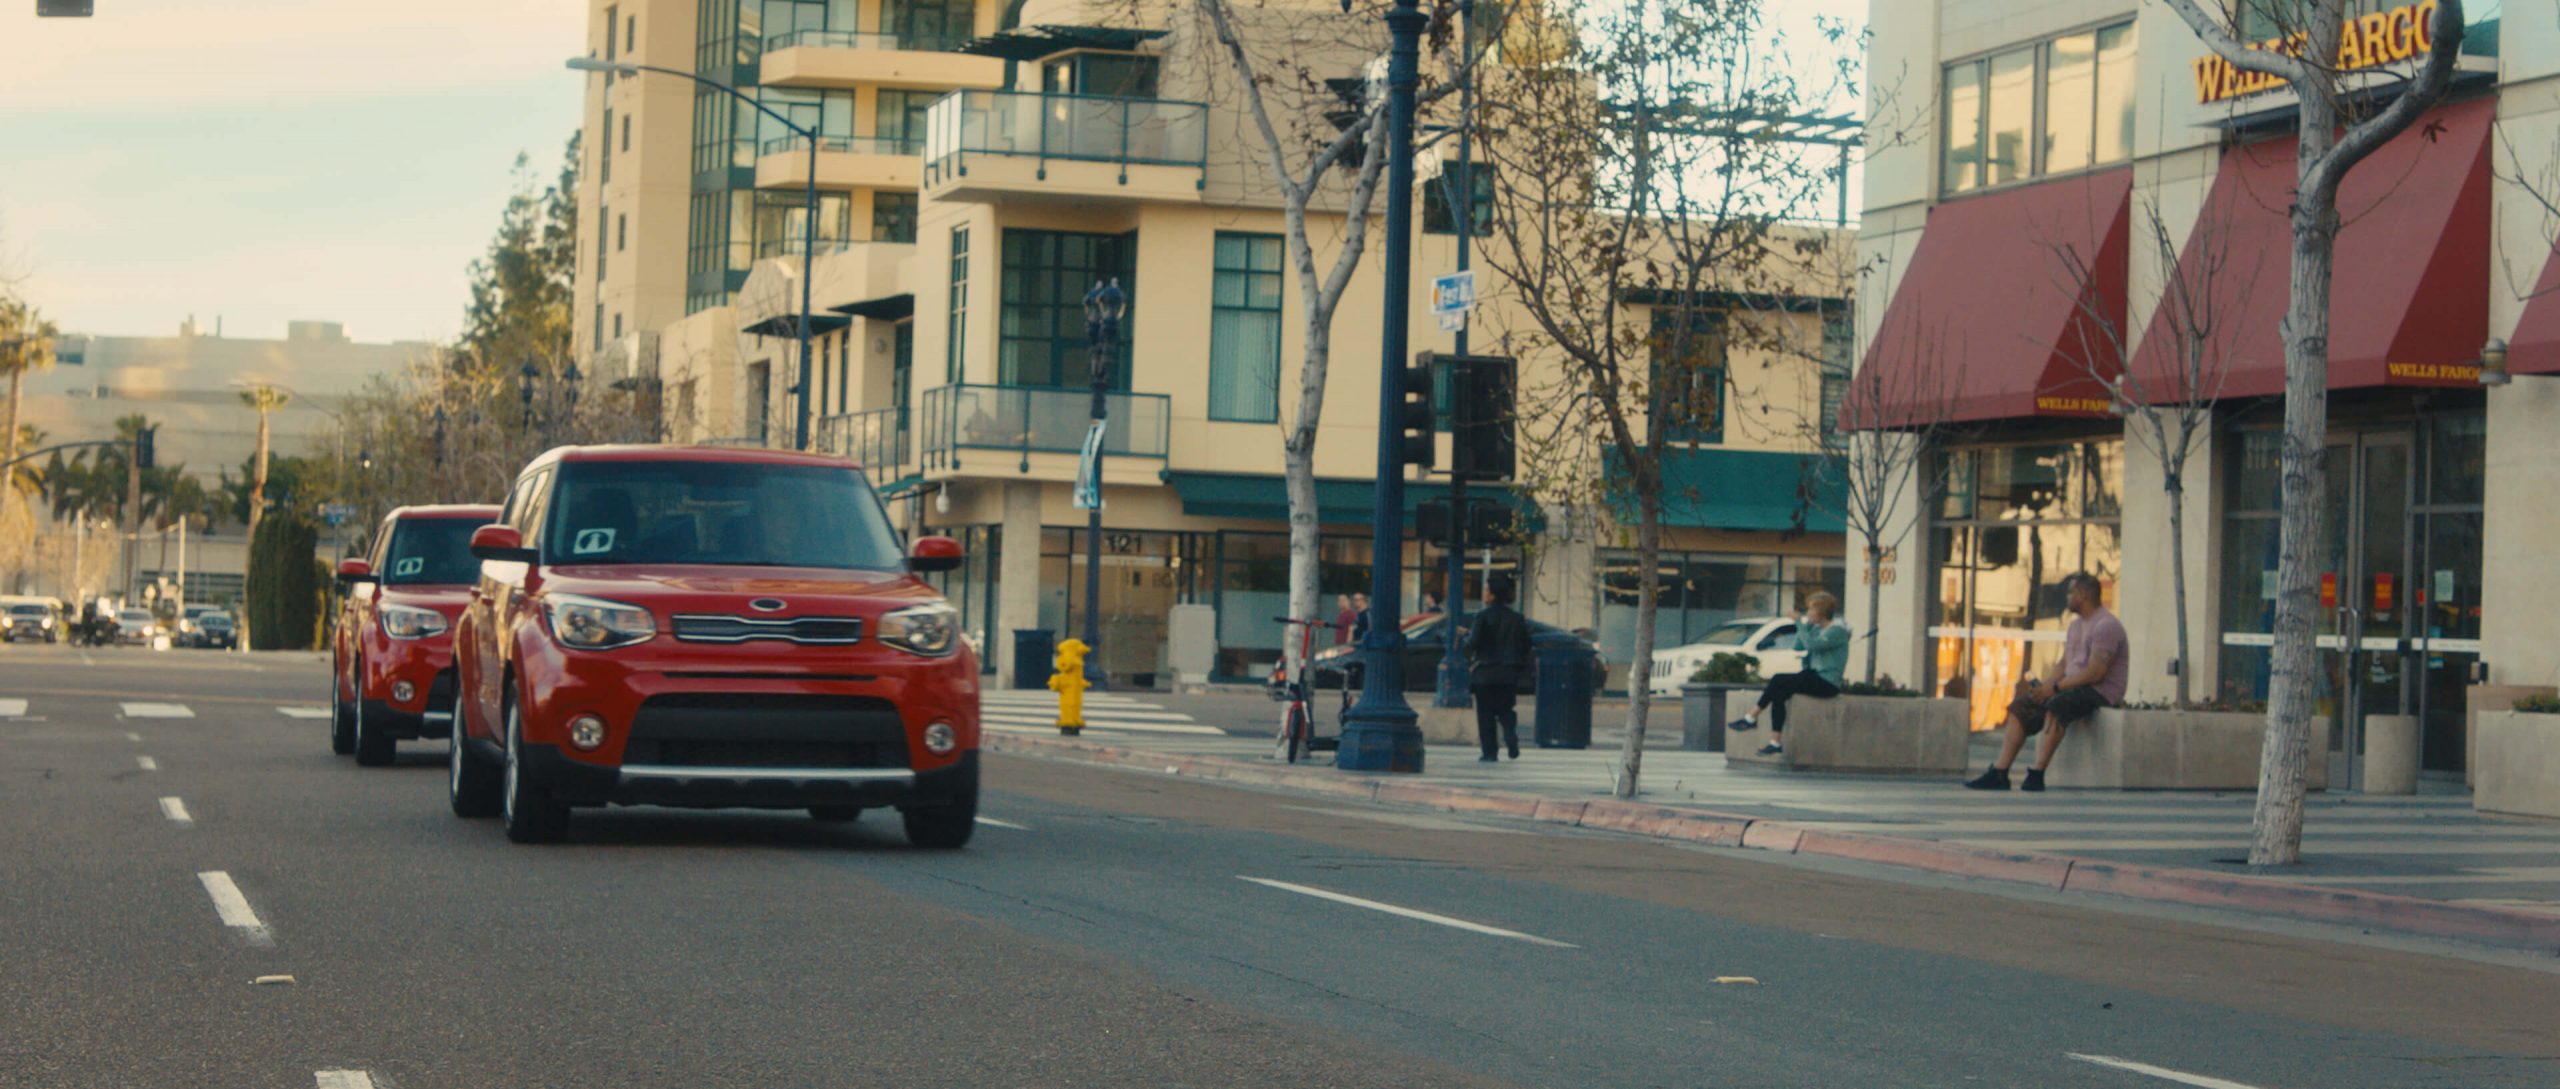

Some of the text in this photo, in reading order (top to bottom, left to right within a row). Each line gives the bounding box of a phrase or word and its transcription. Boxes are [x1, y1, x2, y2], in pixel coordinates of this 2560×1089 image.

[2390, 364, 2437, 378] WELLS
[2038, 397, 2079, 410] WELLS
[1106, 534, 1141, 552] 121
